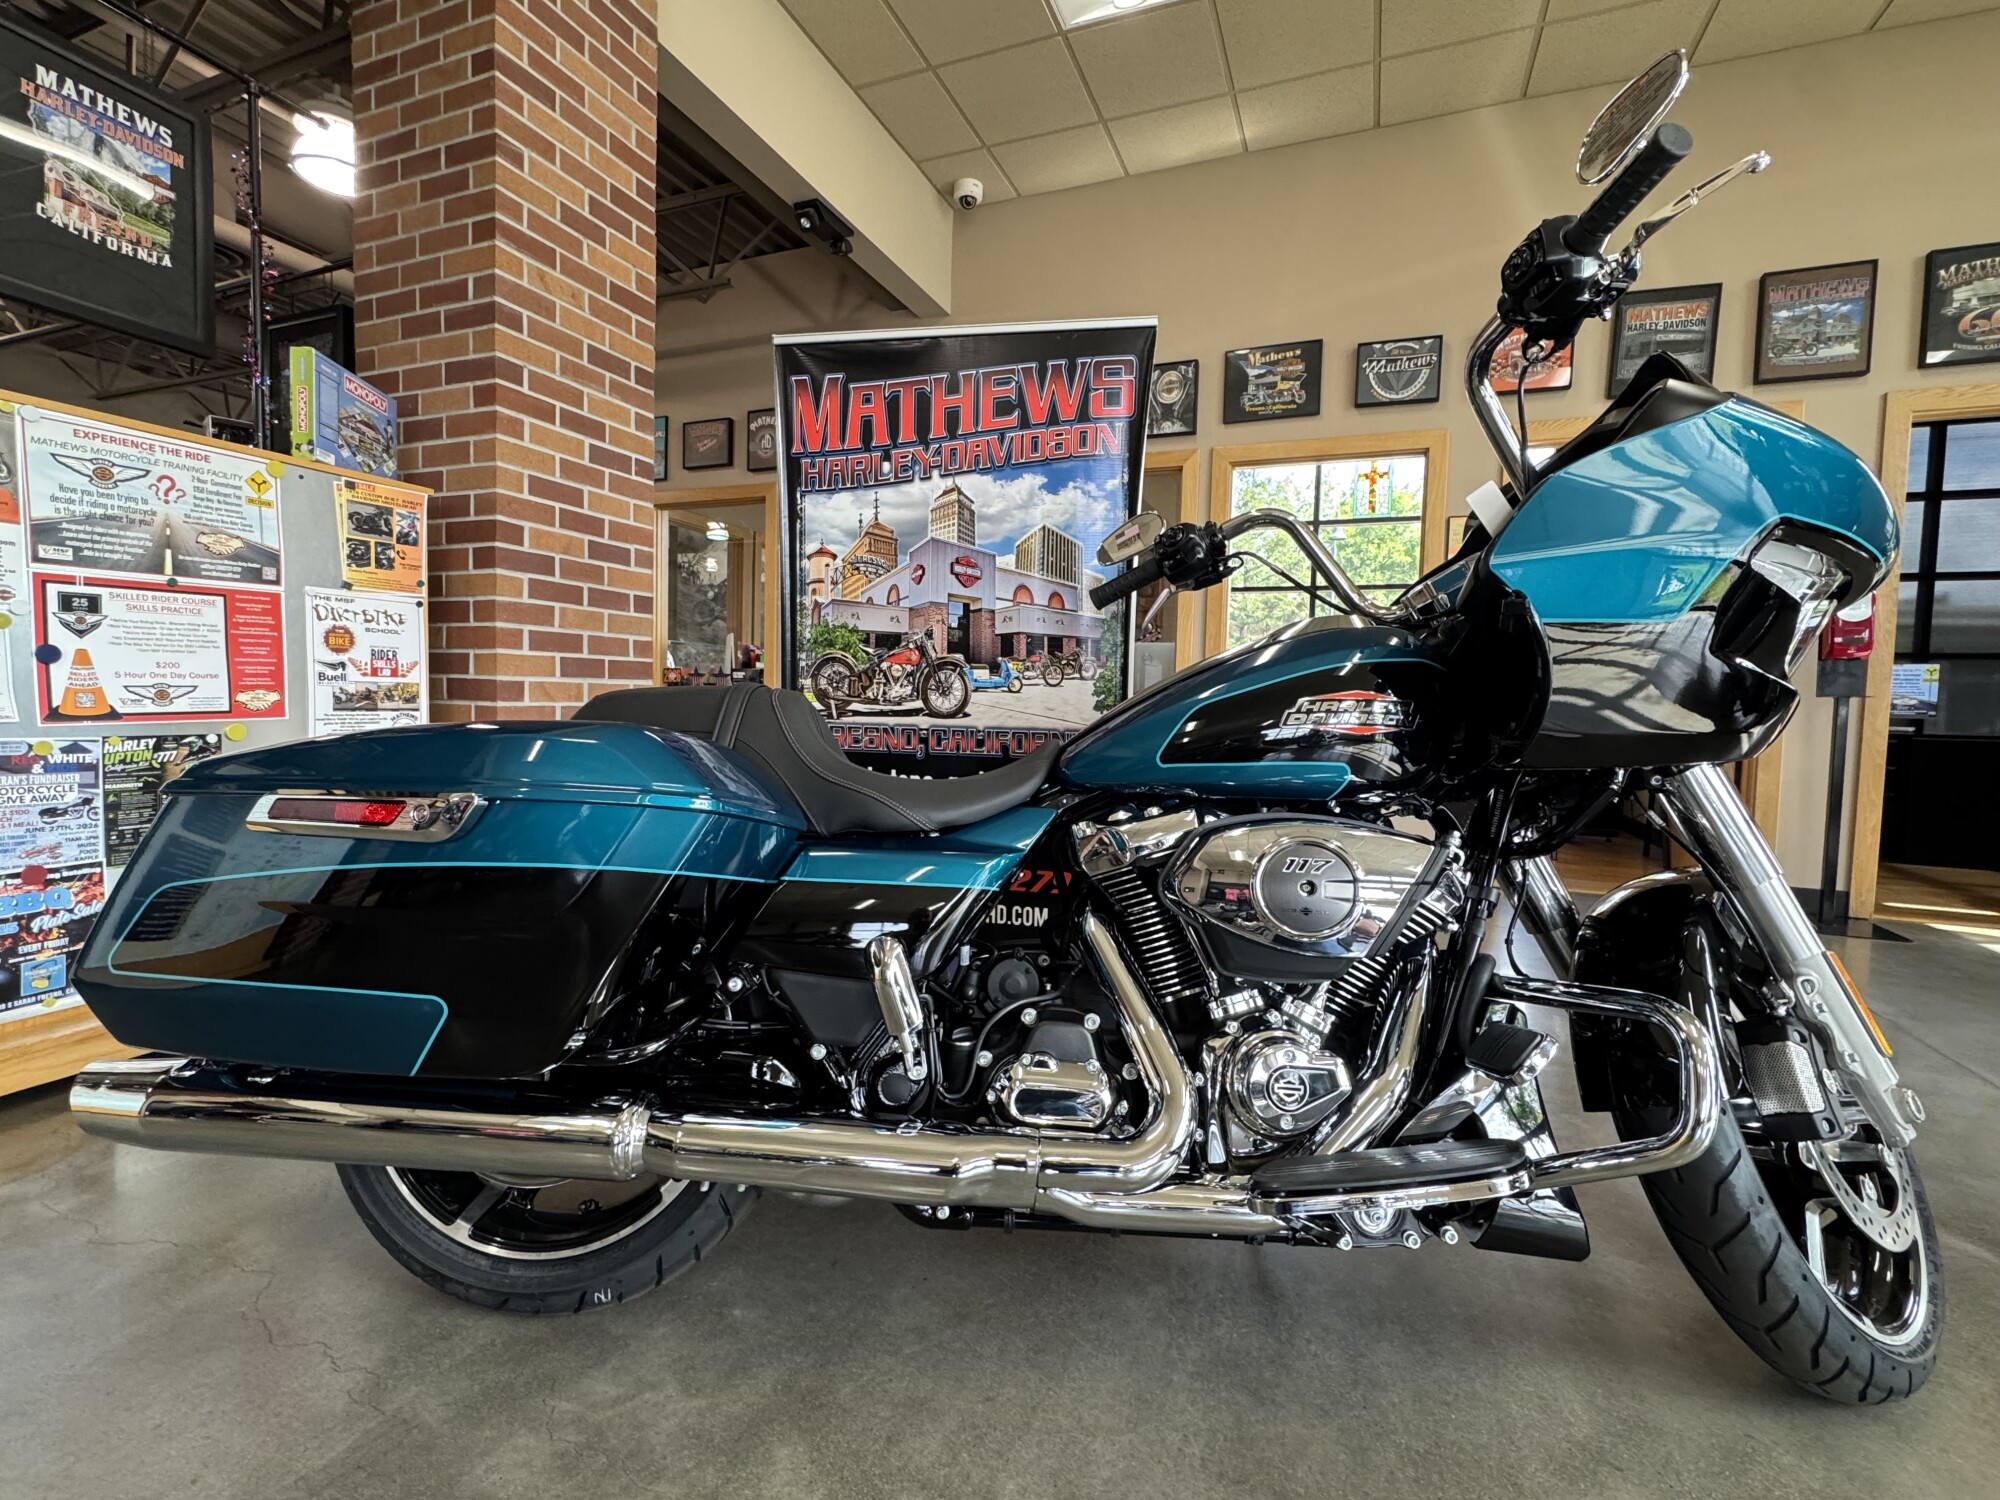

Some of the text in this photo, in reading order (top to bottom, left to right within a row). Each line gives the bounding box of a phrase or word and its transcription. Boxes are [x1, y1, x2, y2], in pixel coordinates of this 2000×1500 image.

[35, 63, 173, 148] MATHEWS
[20, 77, 185, 169] HARLEY-DAVIDSON
[63, 200, 153, 247] FRESNO
[36, 201, 173, 268] CALIFORNIA
[1627, 302, 1708, 323] MATHEWS
[1627, 318, 1707, 333] HARLEY-DAVIDSON
[1248, 348, 1302, 367] Mathews
[1362, 353, 1438, 375] Mathews
[345, 378, 387, 411] MONOPOLY
[790, 355, 1139, 455] MATHEWS
[750, 416, 777, 431] MATHE
[73, 428, 211, 463] EXPERIENCE THE RIDE
[30, 436, 243, 482] MATHEWS MOTORCYCLE TRAINING FACILITY
[801, 422, 1124, 492] HARLEY-DAVIDSON
[59, 483, 149, 505] Have you been trying to
[206, 488, 232, 499] Enrollment
[352, 494, 379, 503] DAVIDSON
[361, 491, 382, 499] CUSTOM
[402, 499, 423, 507] HARLEY
[50, 493, 76, 506] decide
[78, 496, 84, 507] if
[86, 497, 108, 511] riding
[117, 503, 158, 517] motorcycle
[248, 498, 272, 507] DECISION
[54, 505, 155, 527] is the right choice for you?
[71, 598, 89, 607] 25
[109, 591, 217, 606] SKILLED RIDER COURSE
[126, 603, 203, 615] SKILLS PRACTICE
[365, 627, 401, 635] SCHOOL
[329, 637, 350, 646] BIKE
[371, 649, 398, 660] RIDER
[372, 660, 396, 668] SKILLS
[125, 671, 147, 679] Hour
[170, 672, 187, 680] Day
[318, 672, 346, 682] Buell
[1301, 700, 1400, 713] HARLEY
[391, 713, 418, 721] MATHEWS
[104, 738, 157, 753] HARLEY
[828, 725, 926, 758] RESNO,
[47, 753, 98, 765] WHITE,
[104, 750, 153, 764] UPTON
[31, 764, 45, 773] &
[105, 763, 137, 772] California
[0, 774, 80, 786] RAN'S FUNDRAISER
[30, 794, 66, 803] AWAY
[1282, 857, 1336, 875] 117
[31, 900, 104, 933] Plate Sale
[18, 943, 42, 955] EVERY
[44, 937, 70, 949] FRIDAY
[37, 990, 64, 1002] FRESNO,
[65, 987, 75, 995] CA
